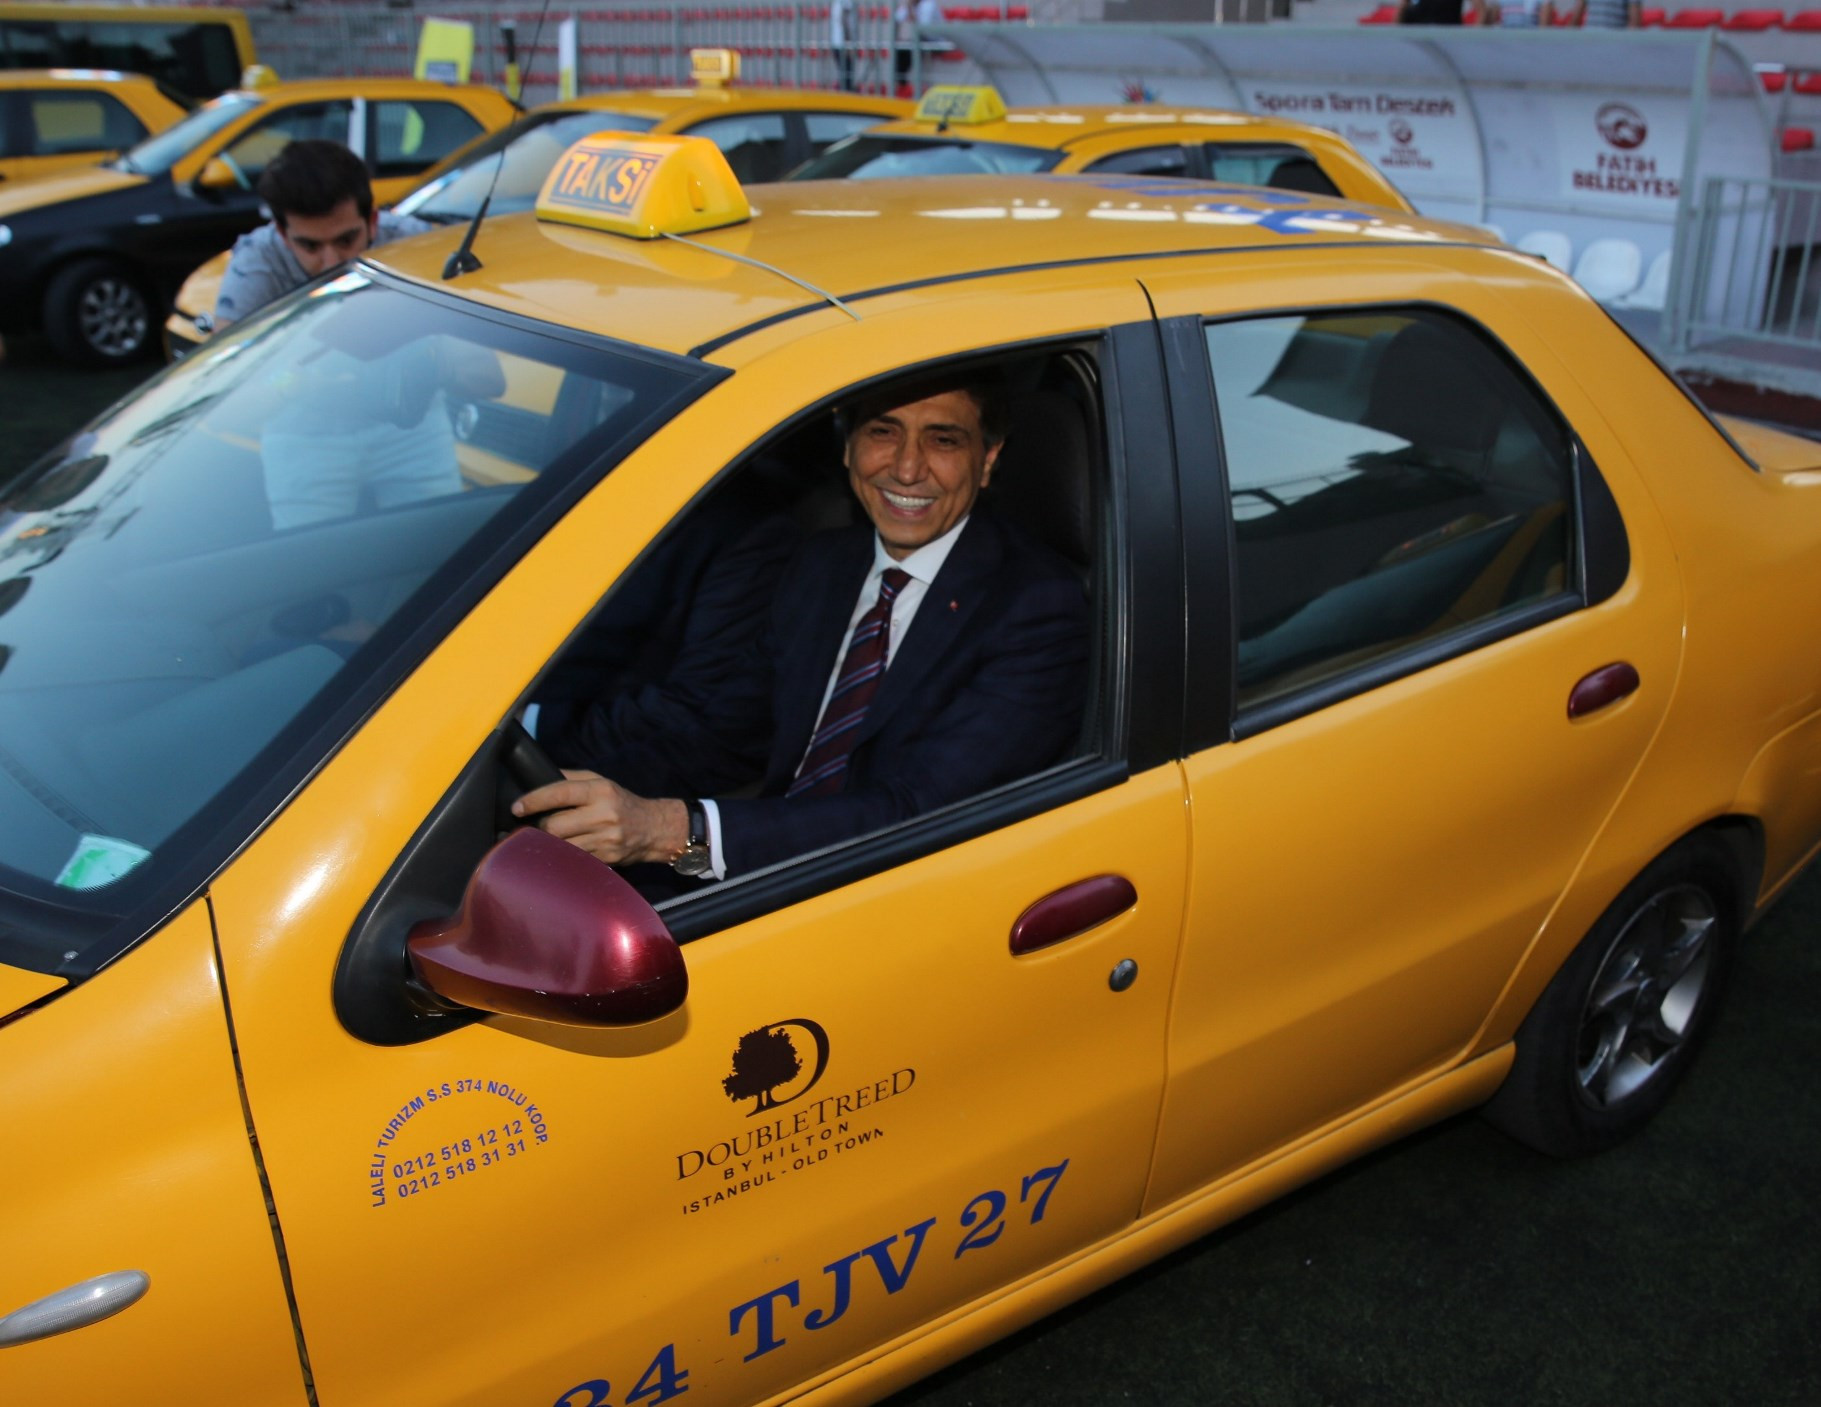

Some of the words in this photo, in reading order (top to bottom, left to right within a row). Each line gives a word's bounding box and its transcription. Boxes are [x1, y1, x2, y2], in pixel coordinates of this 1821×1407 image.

[426, 1083, 451, 1102] S.S
[456, 1079, 482, 1093] 374
[486, 1080, 528, 1106] NOLU
[377, 1096, 425, 1148] TURIZM
[393, 1152, 436, 1178] 0212
[441, 1139, 472, 1161] 518
[477, 1129, 498, 1147] 12
[503, 1120, 523, 1137] 12
[524, 1104, 548, 1146] KOOP.
[398, 1171, 441, 1198] 0212
[446, 1158, 476, 1180] 518
[481, 1148, 500, 1166] 31
[506, 1139, 526, 1156] 31
[683, 1171, 776, 1215] ISTANBUL
[793, 1148, 829, 1171] OLD
[834, 1127, 884, 1154] TOWN
[723, 1159, 752, 1180] BY
[762, 1121, 849, 1165] HILTON
[370, 1153, 386, 1207] LALELI
[729, 1216, 937, 1363] TJV
[953, 1158, 1070, 1260] 27
